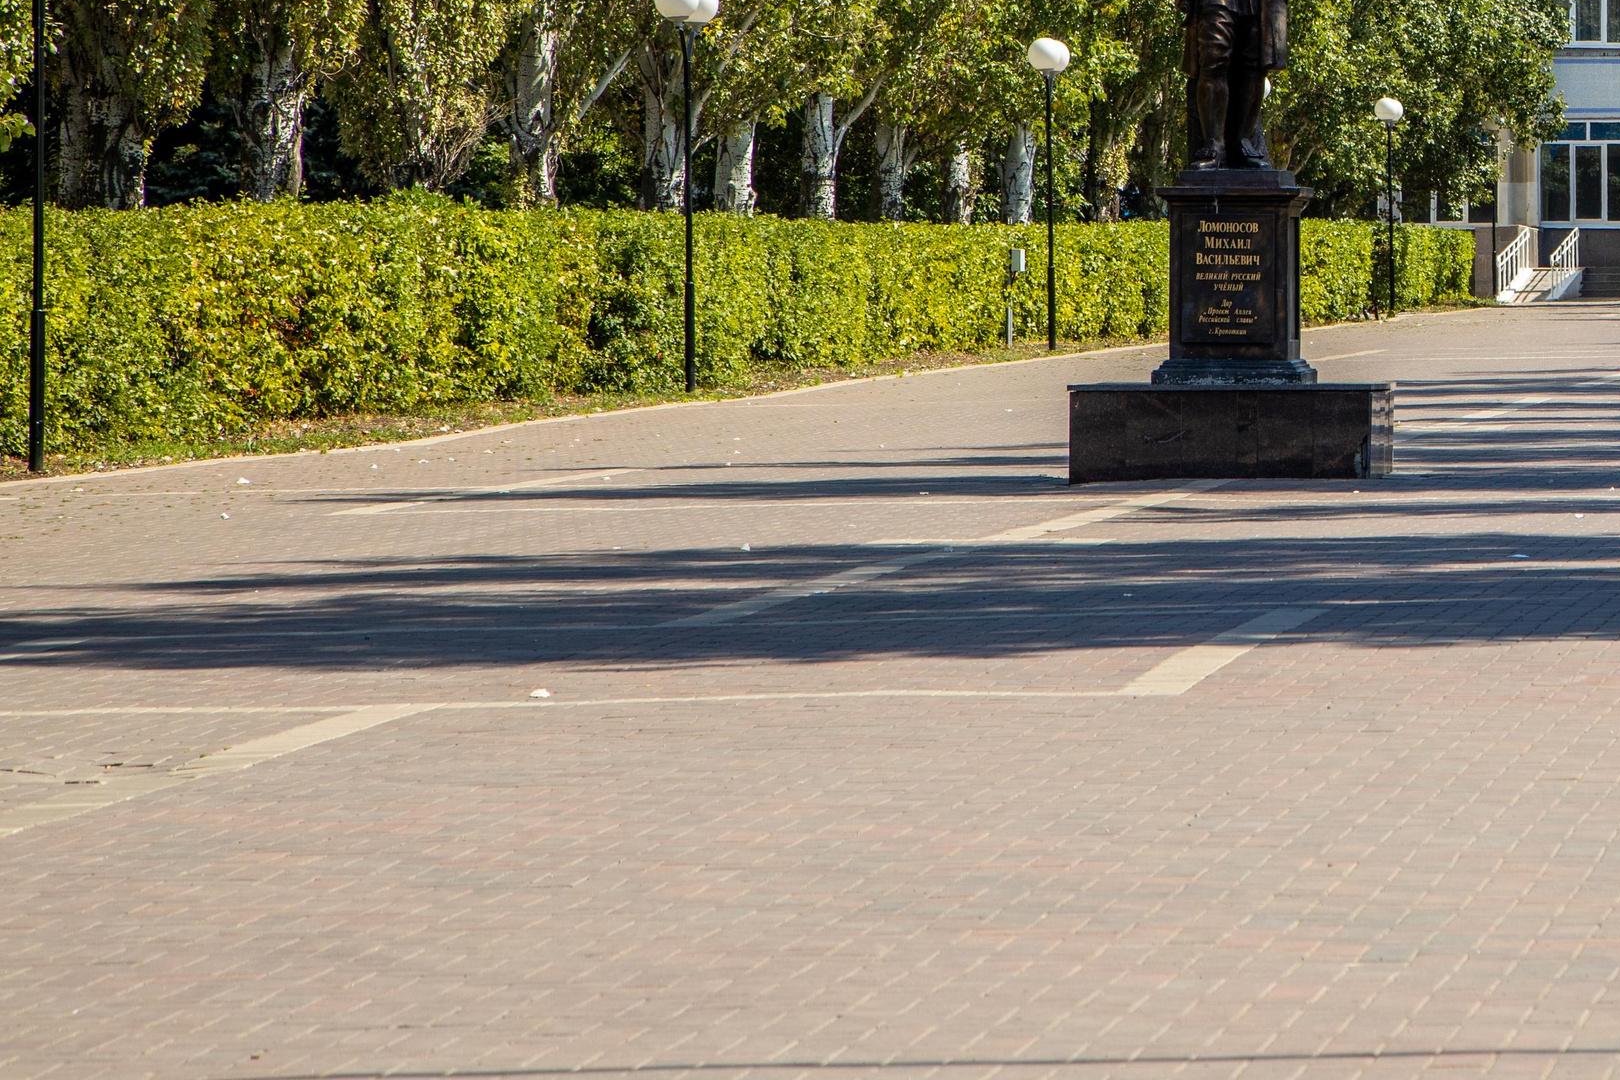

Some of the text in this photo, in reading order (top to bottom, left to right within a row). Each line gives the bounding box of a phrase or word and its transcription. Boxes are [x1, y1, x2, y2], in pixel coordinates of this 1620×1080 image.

[1197, 220, 1259, 233] ЛОМОНОСОВ
[1204, 236, 1251, 249] МИХАИЛ
[1196, 253, 1260, 266] ВАСИЛЬЕВИЧ
[1196, 271, 1261, 281] ВЕЛИКИЙ РУССКИЙ
